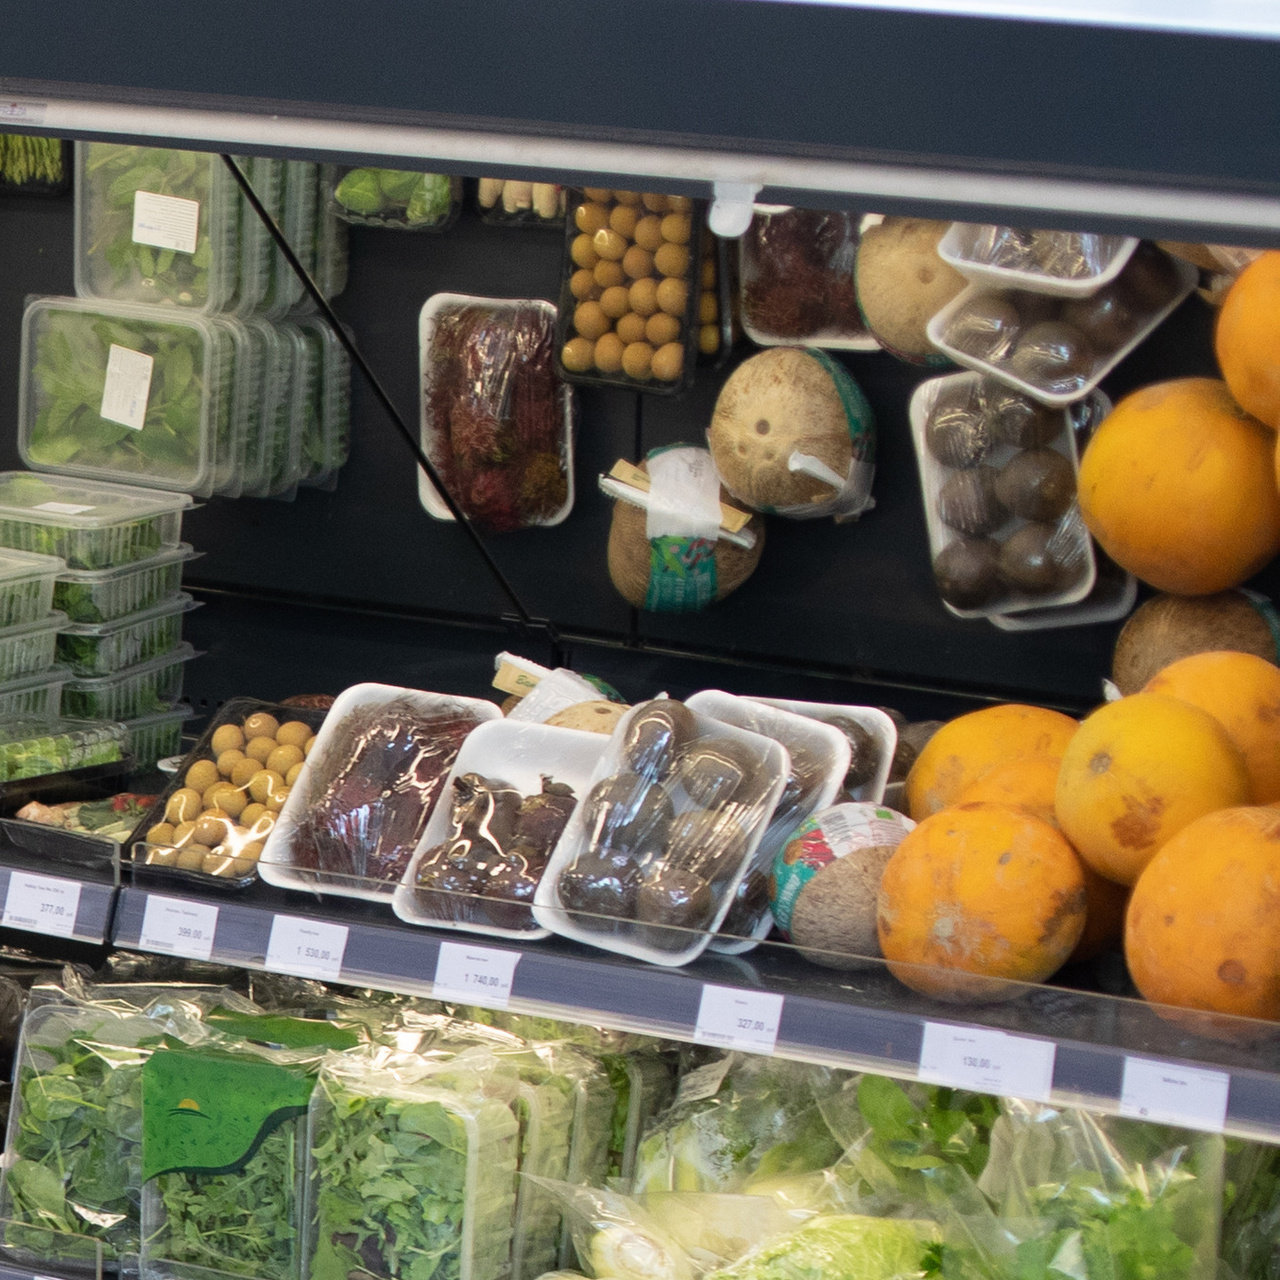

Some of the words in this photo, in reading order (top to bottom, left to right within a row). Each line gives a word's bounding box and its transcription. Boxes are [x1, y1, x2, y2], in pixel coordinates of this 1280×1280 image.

[40, 903, 65, 916] 377,00
[178, 926, 202, 940] 399,00
[305, 947, 330, 960] 530,00
[473, 974, 499, 987] 740,00
[737, 1018, 764, 1031] 327,00
